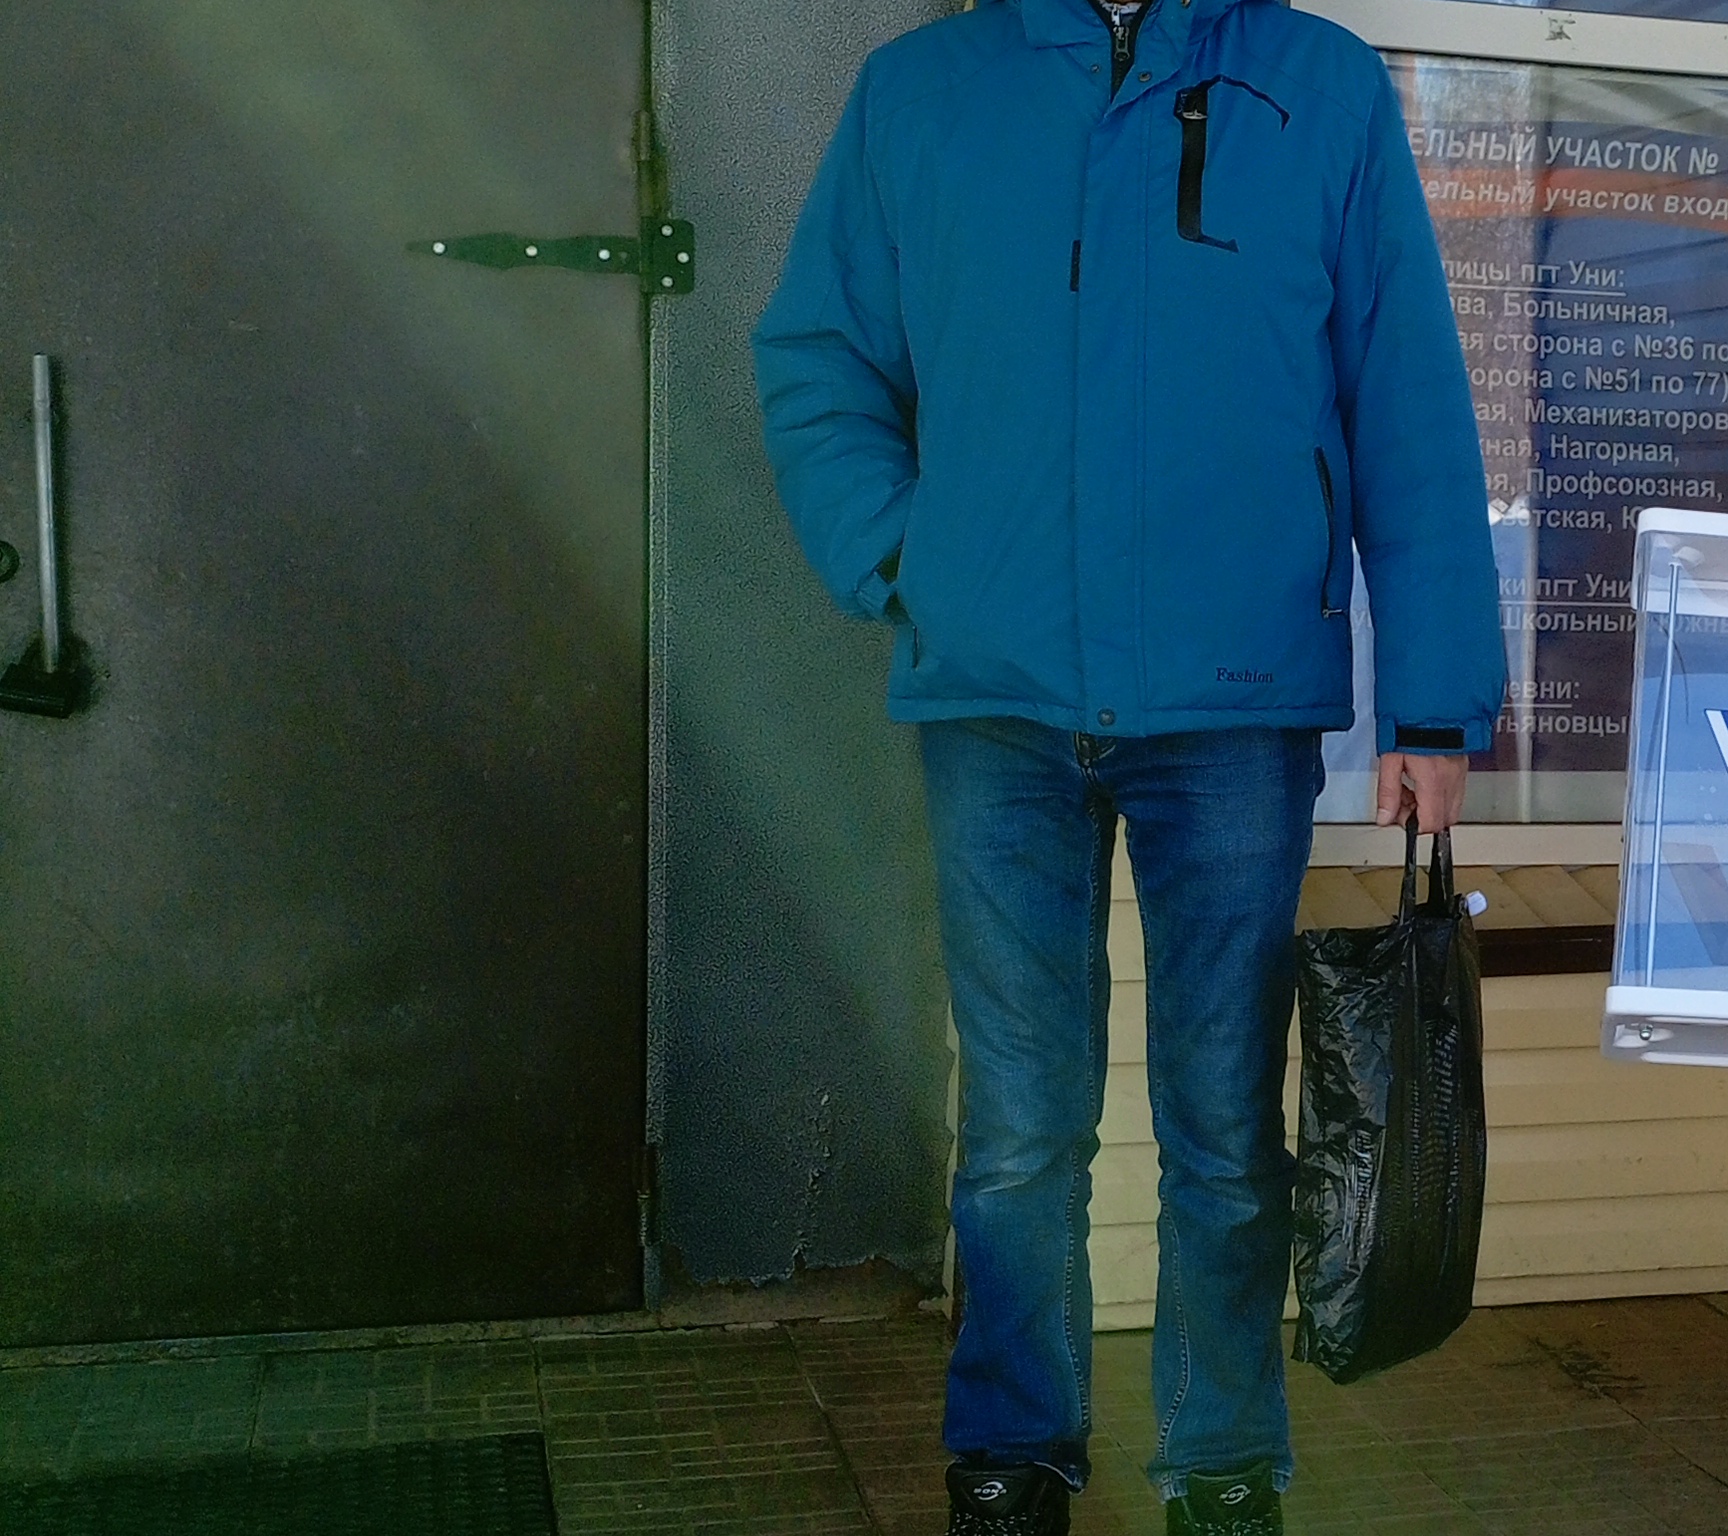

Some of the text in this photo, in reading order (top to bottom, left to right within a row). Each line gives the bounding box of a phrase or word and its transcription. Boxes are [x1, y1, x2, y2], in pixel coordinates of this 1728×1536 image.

[1545, 136, 1681, 173] УЧАСТОК
[1688, 146, 1719, 175] №
[1421, 179, 1537, 205] ельный
[1543, 187, 1655, 212] участок
[1521, 263, 1561, 284] пгт
[1568, 260, 1625, 288] Уни:
[1503, 292, 1675, 328] Больничная,
[1493, 333, 1603, 359] сторона
[1611, 339, 1626, 357] с
[1634, 334, 1695, 360] №36
[1467, 367, 1553, 392] орона
[1562, 370, 1576, 389] с
[1585, 366, 1641, 392] №51
[1651, 375, 1684, 394] по
[1473, 402, 1514, 426] ая,
[1550, 434, 1680, 466] Нагорная,
[1526, 468, 1723, 502] Профсоюзная,
[1536, 578, 1578, 597] пгт
[1216, 666, 1274, 684] Fashion
[1504, 680, 1580, 700] евни:
